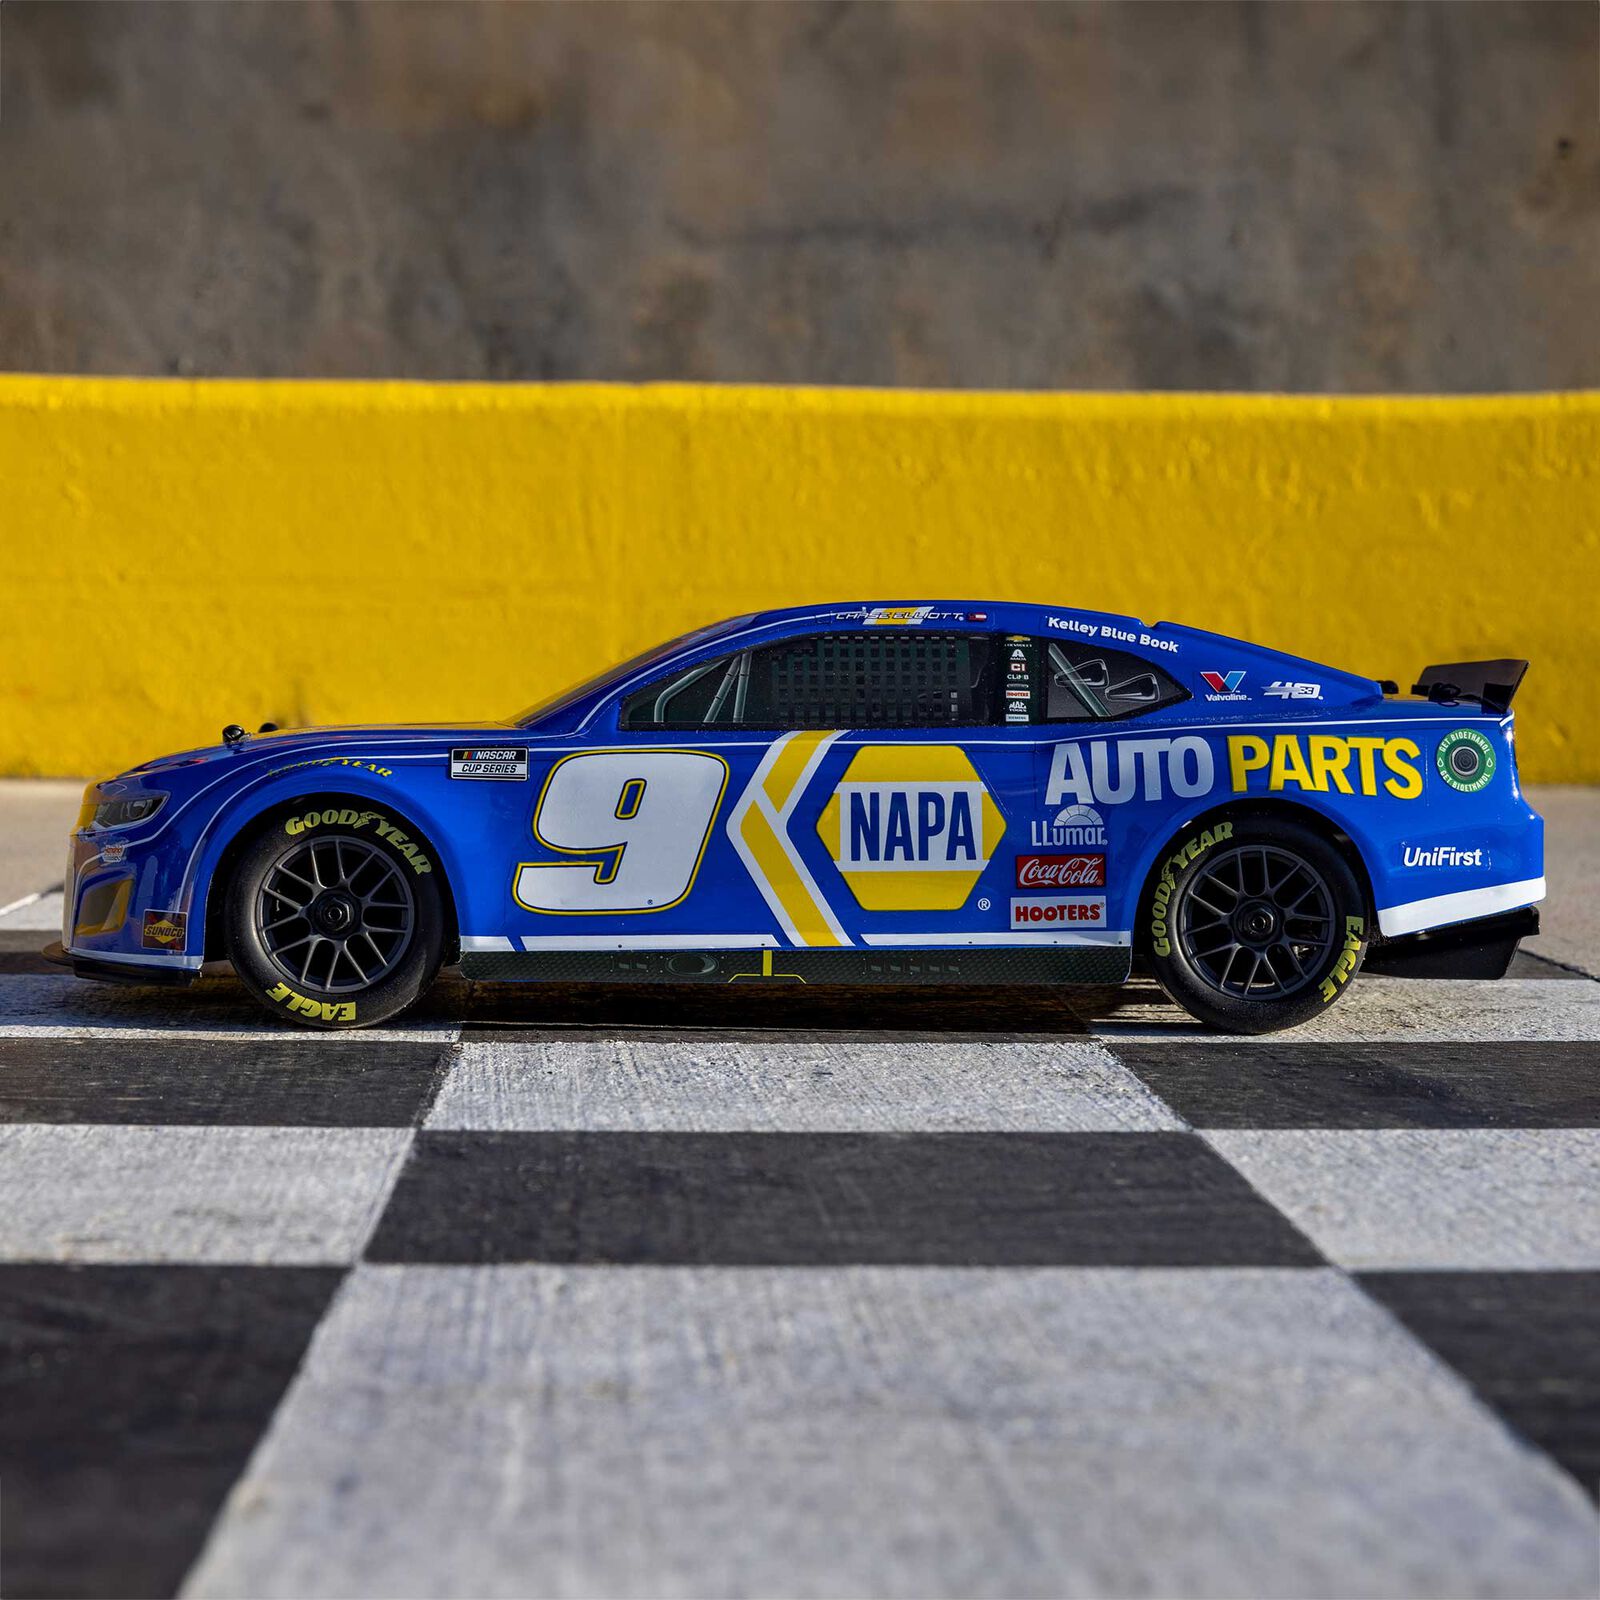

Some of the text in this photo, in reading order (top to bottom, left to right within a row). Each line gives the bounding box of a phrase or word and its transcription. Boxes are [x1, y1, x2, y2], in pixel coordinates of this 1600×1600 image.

[893, 611, 964, 620] ELLIOTT
[1047, 617, 1180, 654] Kelley Blue Book
[1205, 693, 1248, 702] Valvoline
[1439, 731, 1491, 755] GET BIOETHANOL
[476, 750, 517, 760] NASCAR
[461, 763, 518, 773] CUP SERIES
[1044, 734, 1424, 805] AUTO PARTS
[1440, 770, 1491, 793] GET BIOETHANOL
[513, 749, 730, 915] 9
[849, 791, 978, 862] NAPA
[1031, 820, 1105, 847] LLumar
[1403, 846, 1483, 867] UniFirst
[1015, 903, 1101, 922] HOOTERS
[145, 926, 184, 938] SUNOCO
[1318, 915, 1364, 1003] EAGLE
[264, 981, 357, 1022] EAGLE
